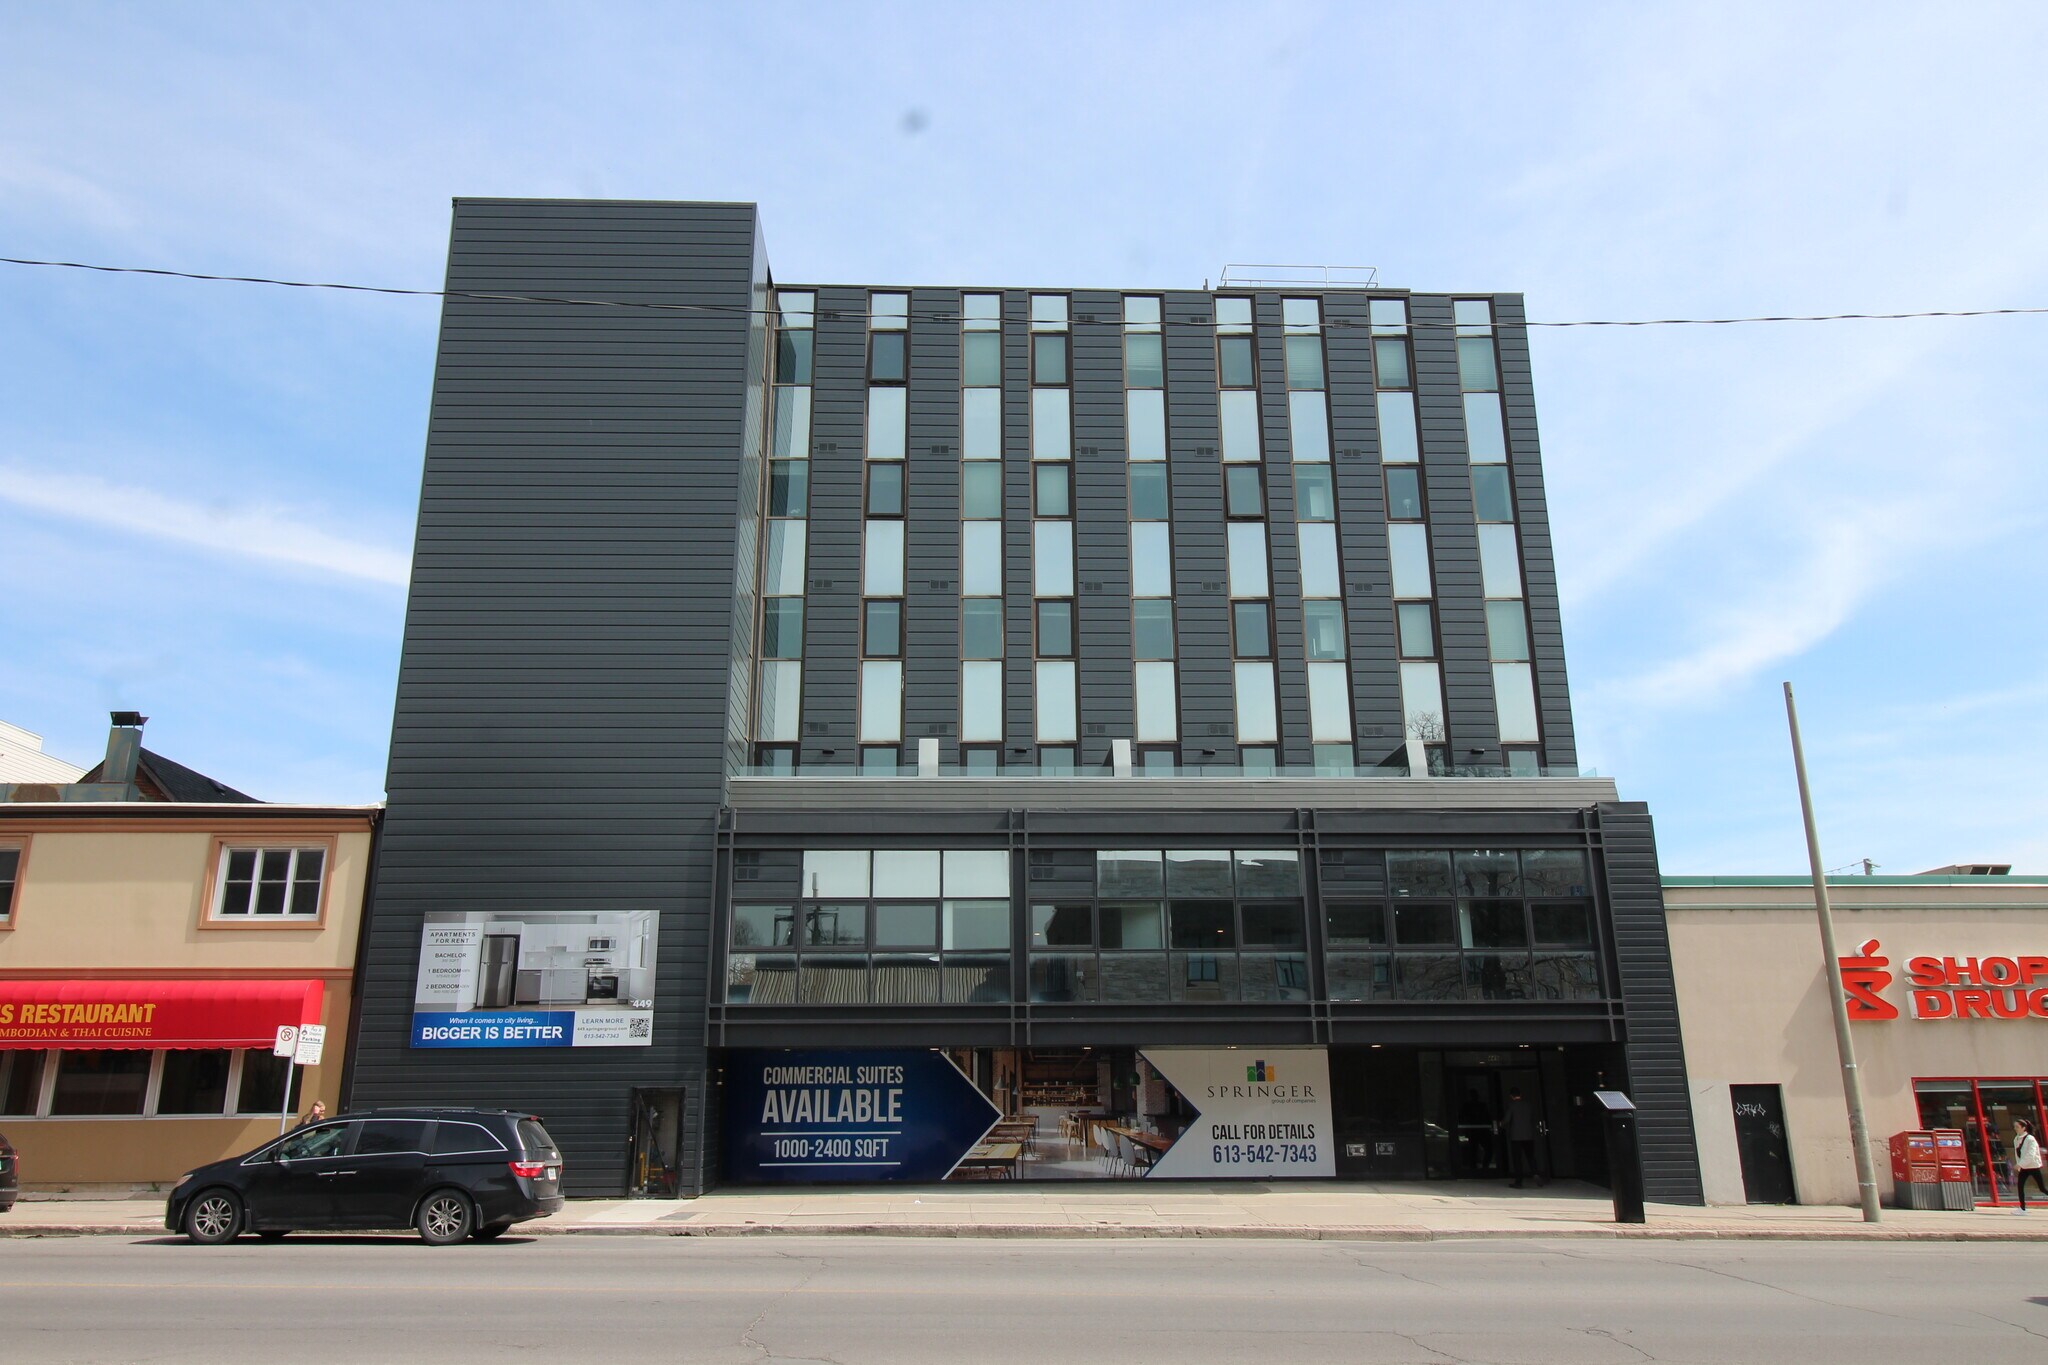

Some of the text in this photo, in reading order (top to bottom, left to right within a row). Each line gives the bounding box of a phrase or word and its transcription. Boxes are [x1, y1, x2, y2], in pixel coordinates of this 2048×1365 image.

[1904, 956, 2048, 987] SHOP
[632, 999, 652, 1008] 449
[20, 1003, 156, 1024] RESTAURANT
[504, 1017, 516, 1025] city
[60, 1029, 70, 1037] &
[72, 1028, 101, 1037] THAI
[104, 1028, 152, 1037] CUISINE
[422, 1026, 563, 1040] BIGGER IS BETTER
[763, 1066, 904, 1085] COMMERCIAL SUITES
[1207, 1085, 1315, 1098] SPRINGER
[761, 1088, 903, 1123] AVAILABLE
[1211, 1123, 1315, 1140] CALL FOR DETAILS
[774, 1138, 889, 1158] 1000-2400 SQFT
[1213, 1144, 1317, 1163] 613-542-7343
